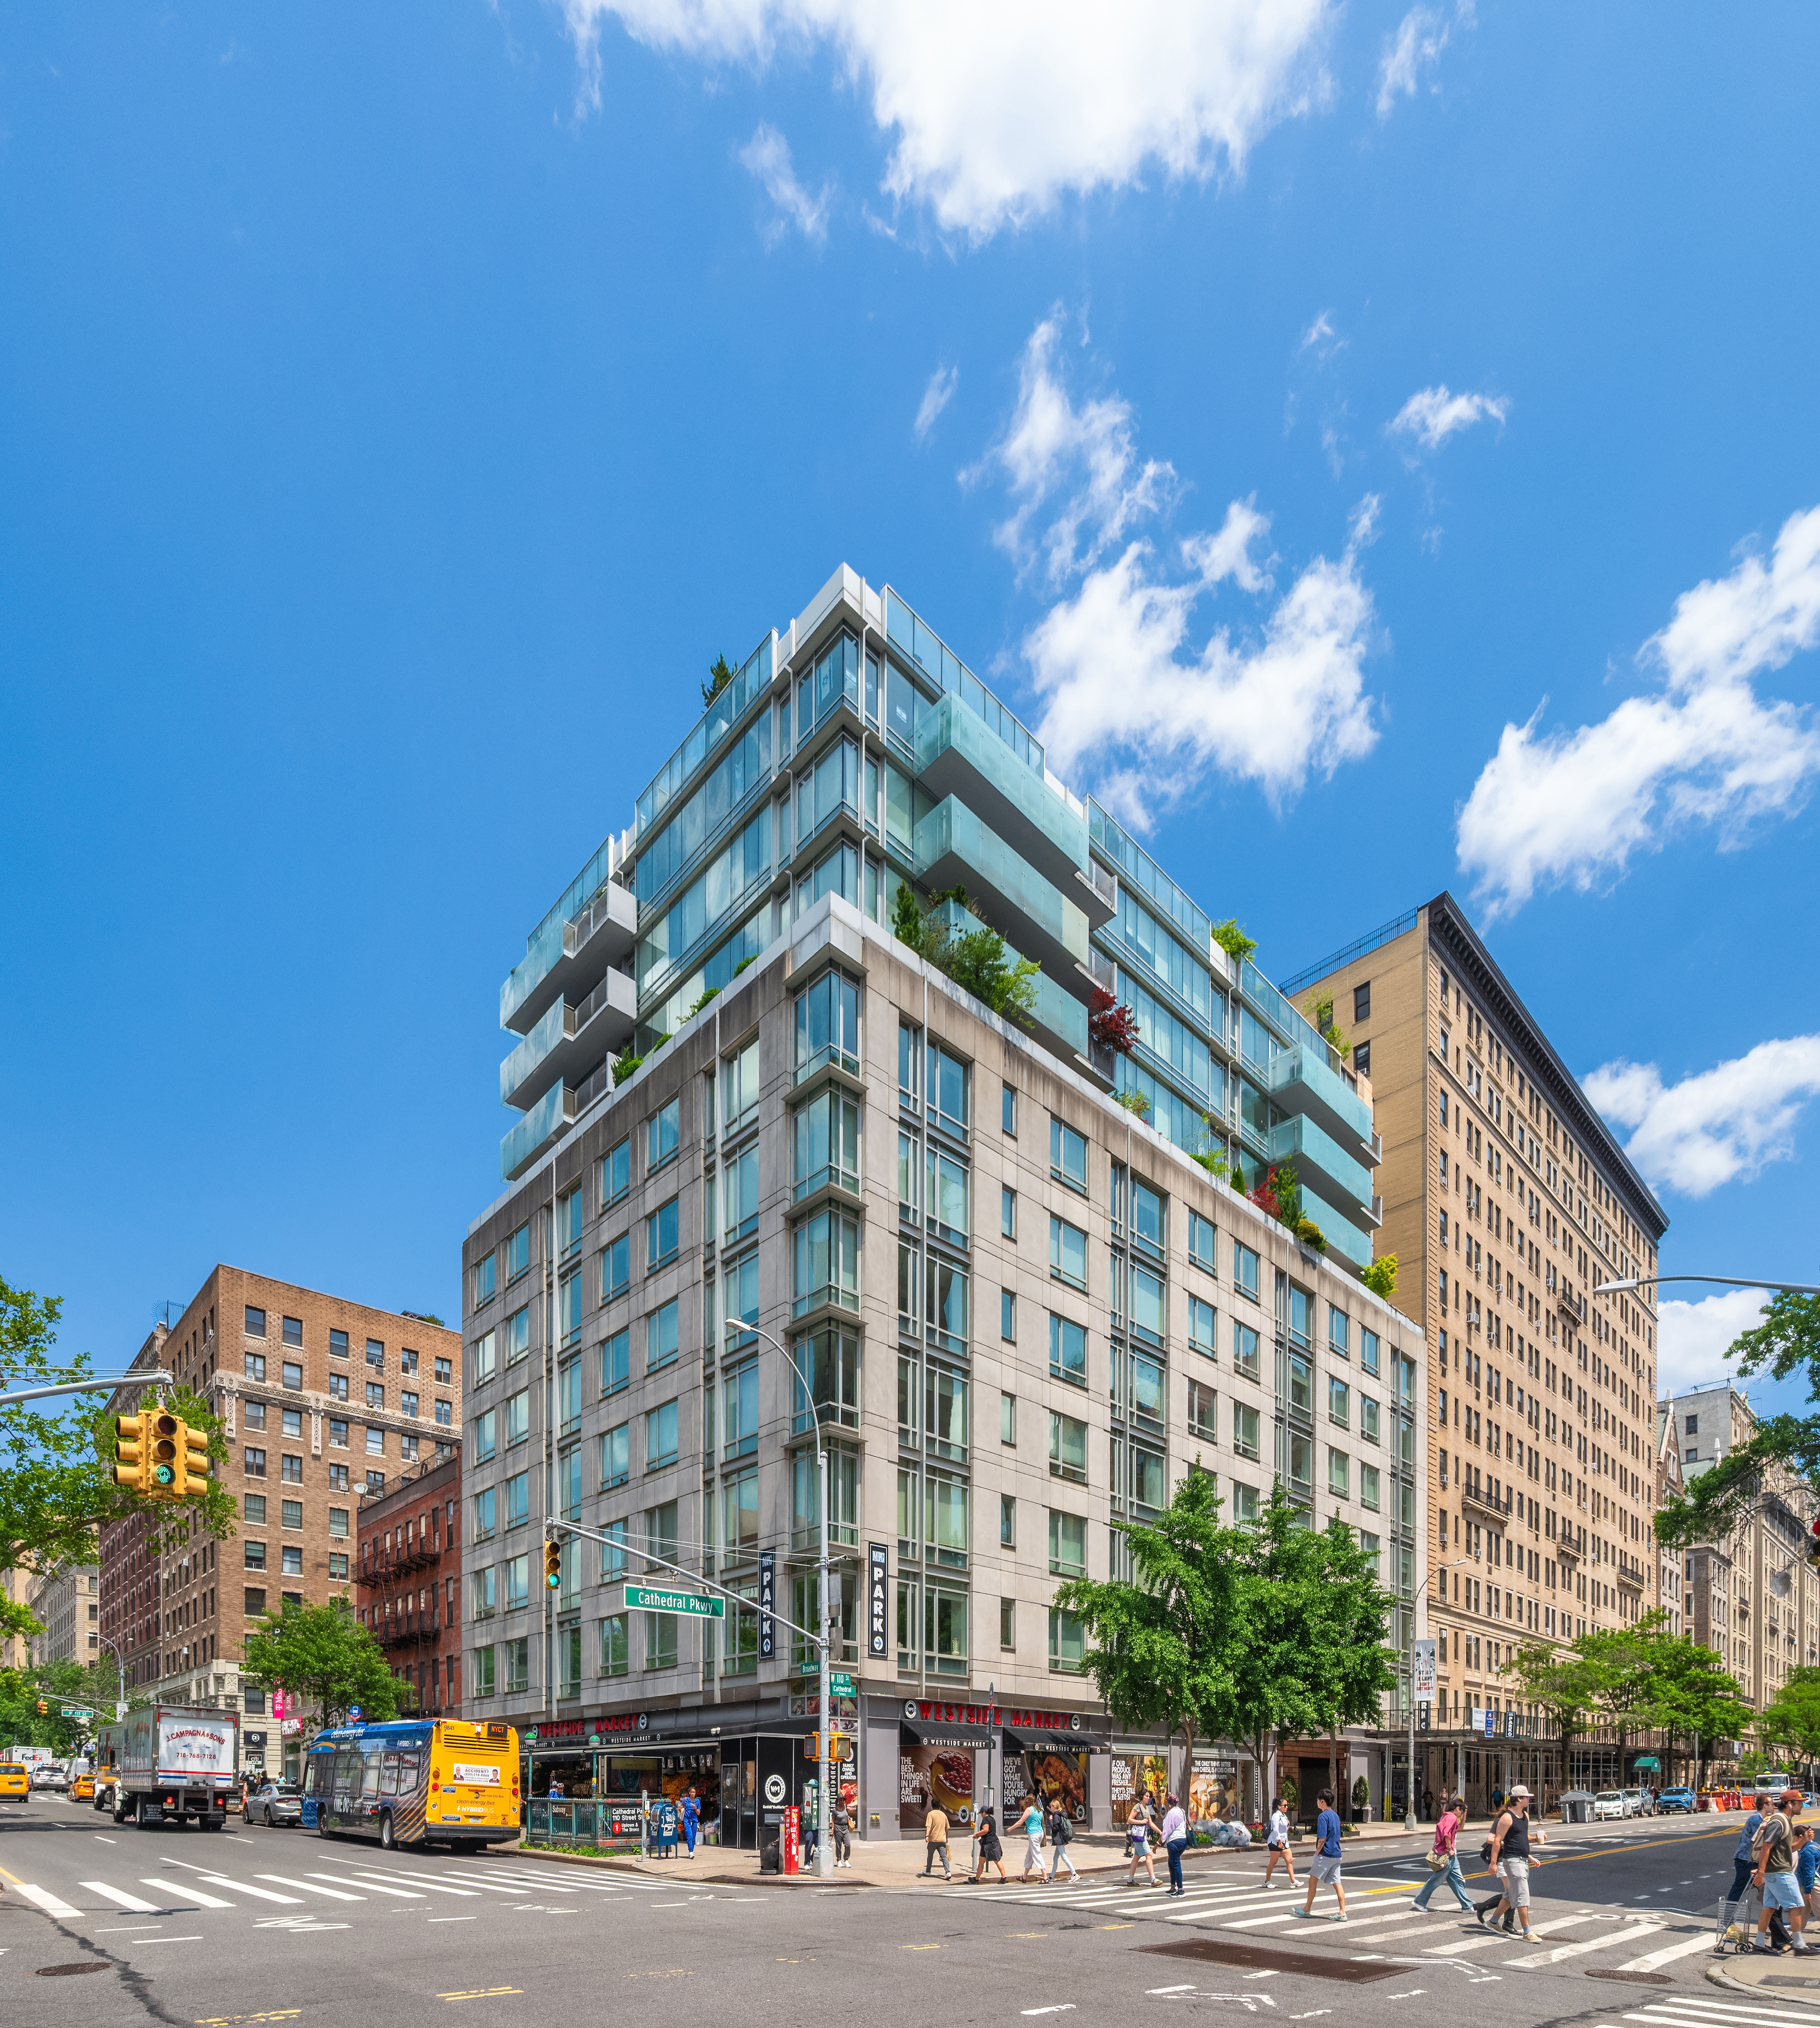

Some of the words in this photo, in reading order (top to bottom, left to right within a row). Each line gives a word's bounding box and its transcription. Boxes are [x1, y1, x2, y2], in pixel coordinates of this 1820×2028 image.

[638, 1592, 686, 1609] Cathedral
[690, 1598, 713, 1614] Pkwy
[873, 1567, 884, 1632] PARK
[802, 1664, 819, 1673] Broadway
[831, 1674, 835, 1683] W
[540, 1720, 583, 1737] WESTSIDE
[595, 1715, 637, 1733] MARKET
[1012, 1711, 1069, 1729] MARKET
[171, 1730, 205, 1740] CAMPAGNA
[210, 1734, 226, 1745] SONS
[355, 1727, 365, 1737] bus
[552, 1805, 566, 1814] Subway
